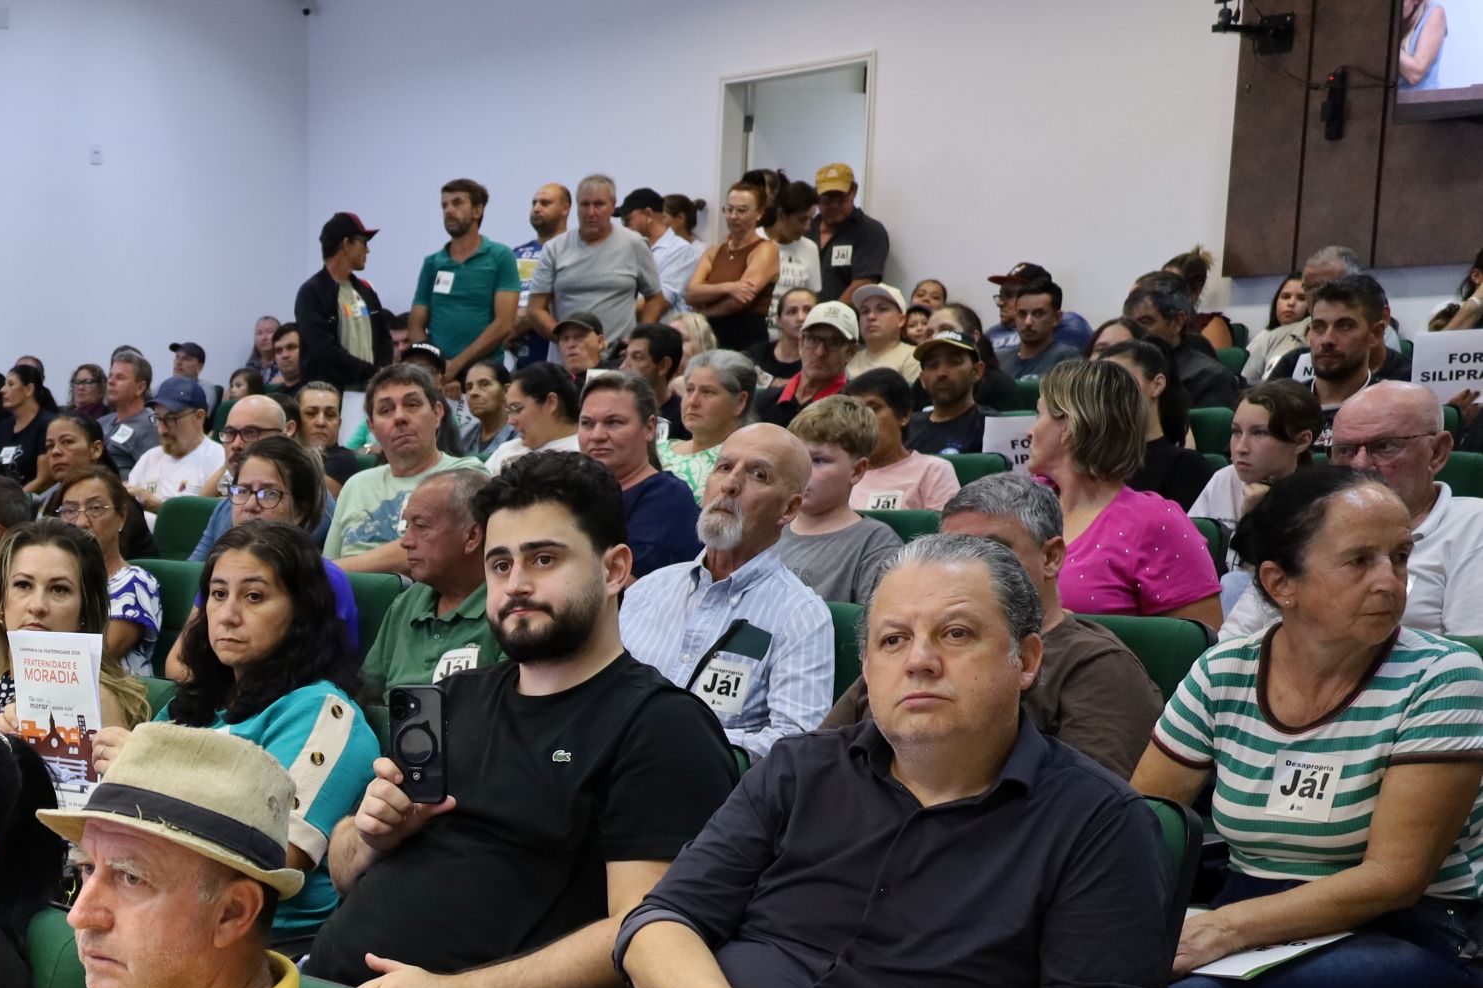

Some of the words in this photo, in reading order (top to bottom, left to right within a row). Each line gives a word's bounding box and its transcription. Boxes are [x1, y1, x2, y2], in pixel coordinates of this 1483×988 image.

[1448, 352, 1483, 364] FOR
[1420, 369, 1483, 382] SILIPR
[1011, 439, 1031, 449] FO
[871, 495, 897, 509] Já!
[24, 658, 72, 669] FRATERNIDADE
[73, 662, 78, 670] E
[24, 668, 80, 685] MORADIA
[708, 666, 744, 676] Desapropria
[703, 673, 741, 698] Já!
[1285, 760, 1334, 772] Desapropria
[1280, 769, 1330, 800] Já!
